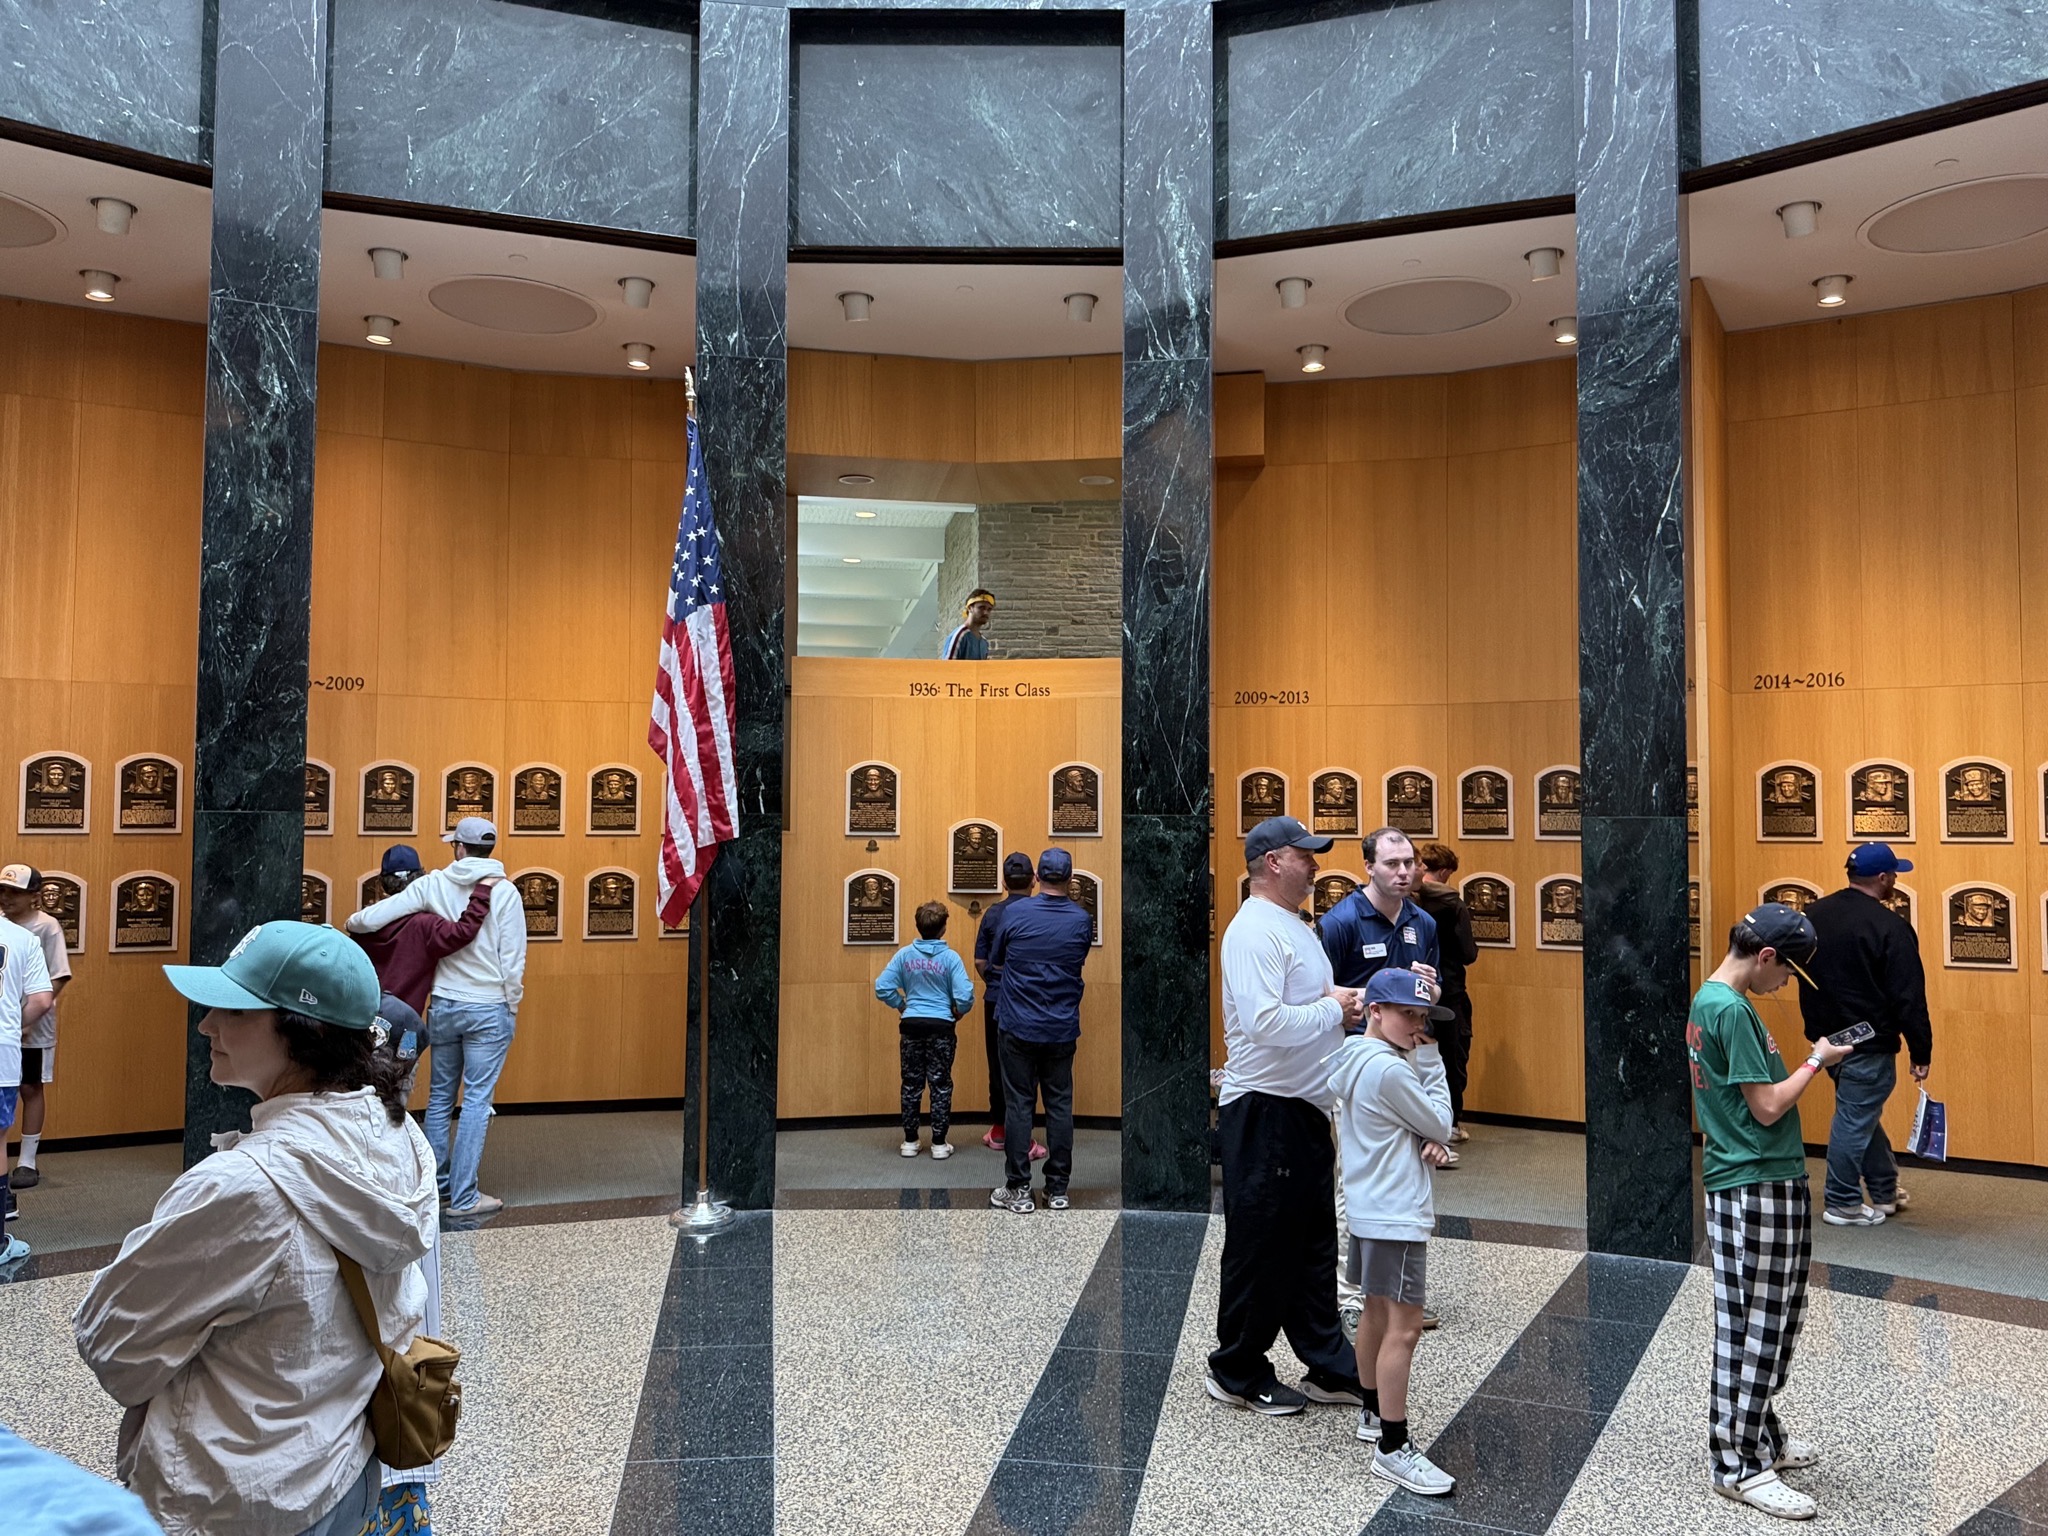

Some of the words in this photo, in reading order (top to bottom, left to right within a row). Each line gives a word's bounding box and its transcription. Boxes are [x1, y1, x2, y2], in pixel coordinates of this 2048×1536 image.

[1754, 672, 1845, 690] 2014~2016
[909, 682, 941, 697] 1936:
[945, 682, 973, 697] The
[980, 682, 1009, 697] First
[1015, 682, 1050, 697] Class
[1234, 690, 1310, 705] 2009~2013
